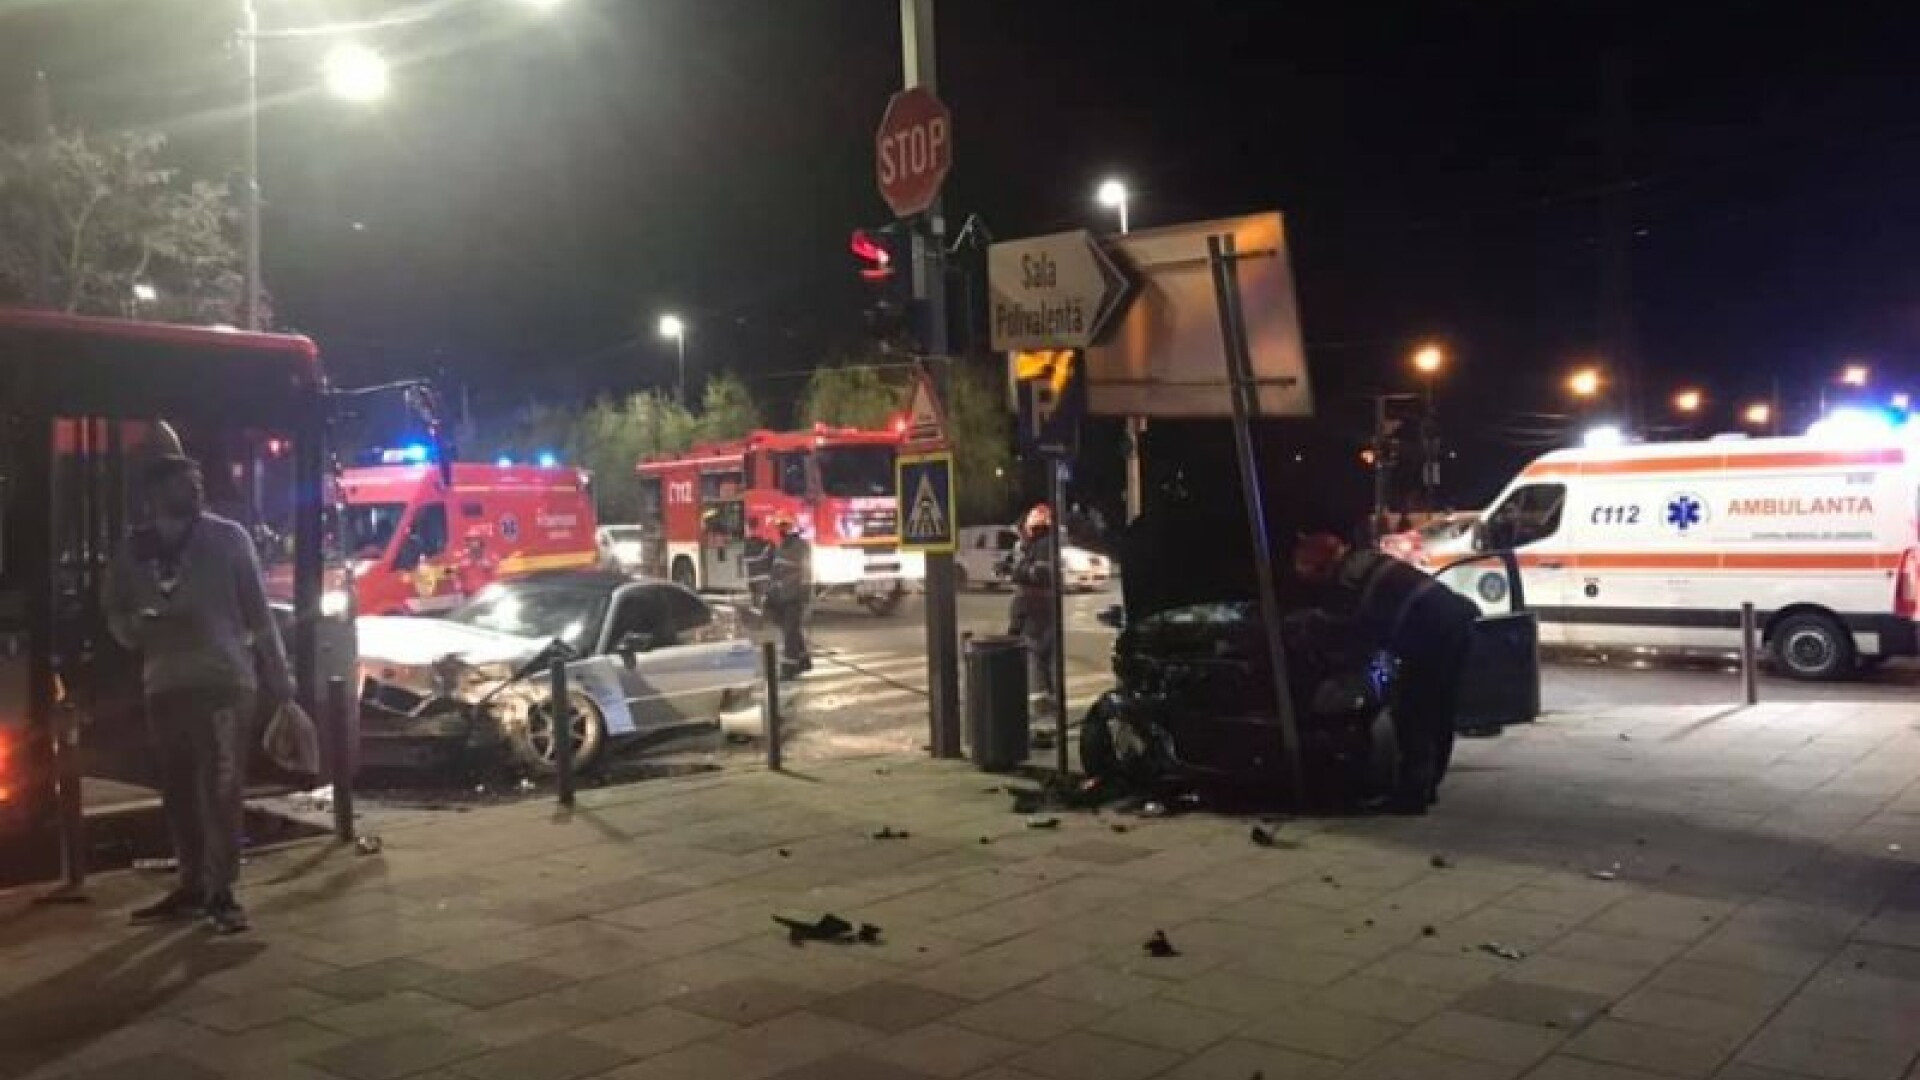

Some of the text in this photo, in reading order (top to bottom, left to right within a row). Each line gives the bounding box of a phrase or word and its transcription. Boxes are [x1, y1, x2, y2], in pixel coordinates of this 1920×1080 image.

[881, 117, 945, 185] STOP
[1022, 251, 1057, 290] Sala
[1728, 496, 1874, 515] AMBULANTA
